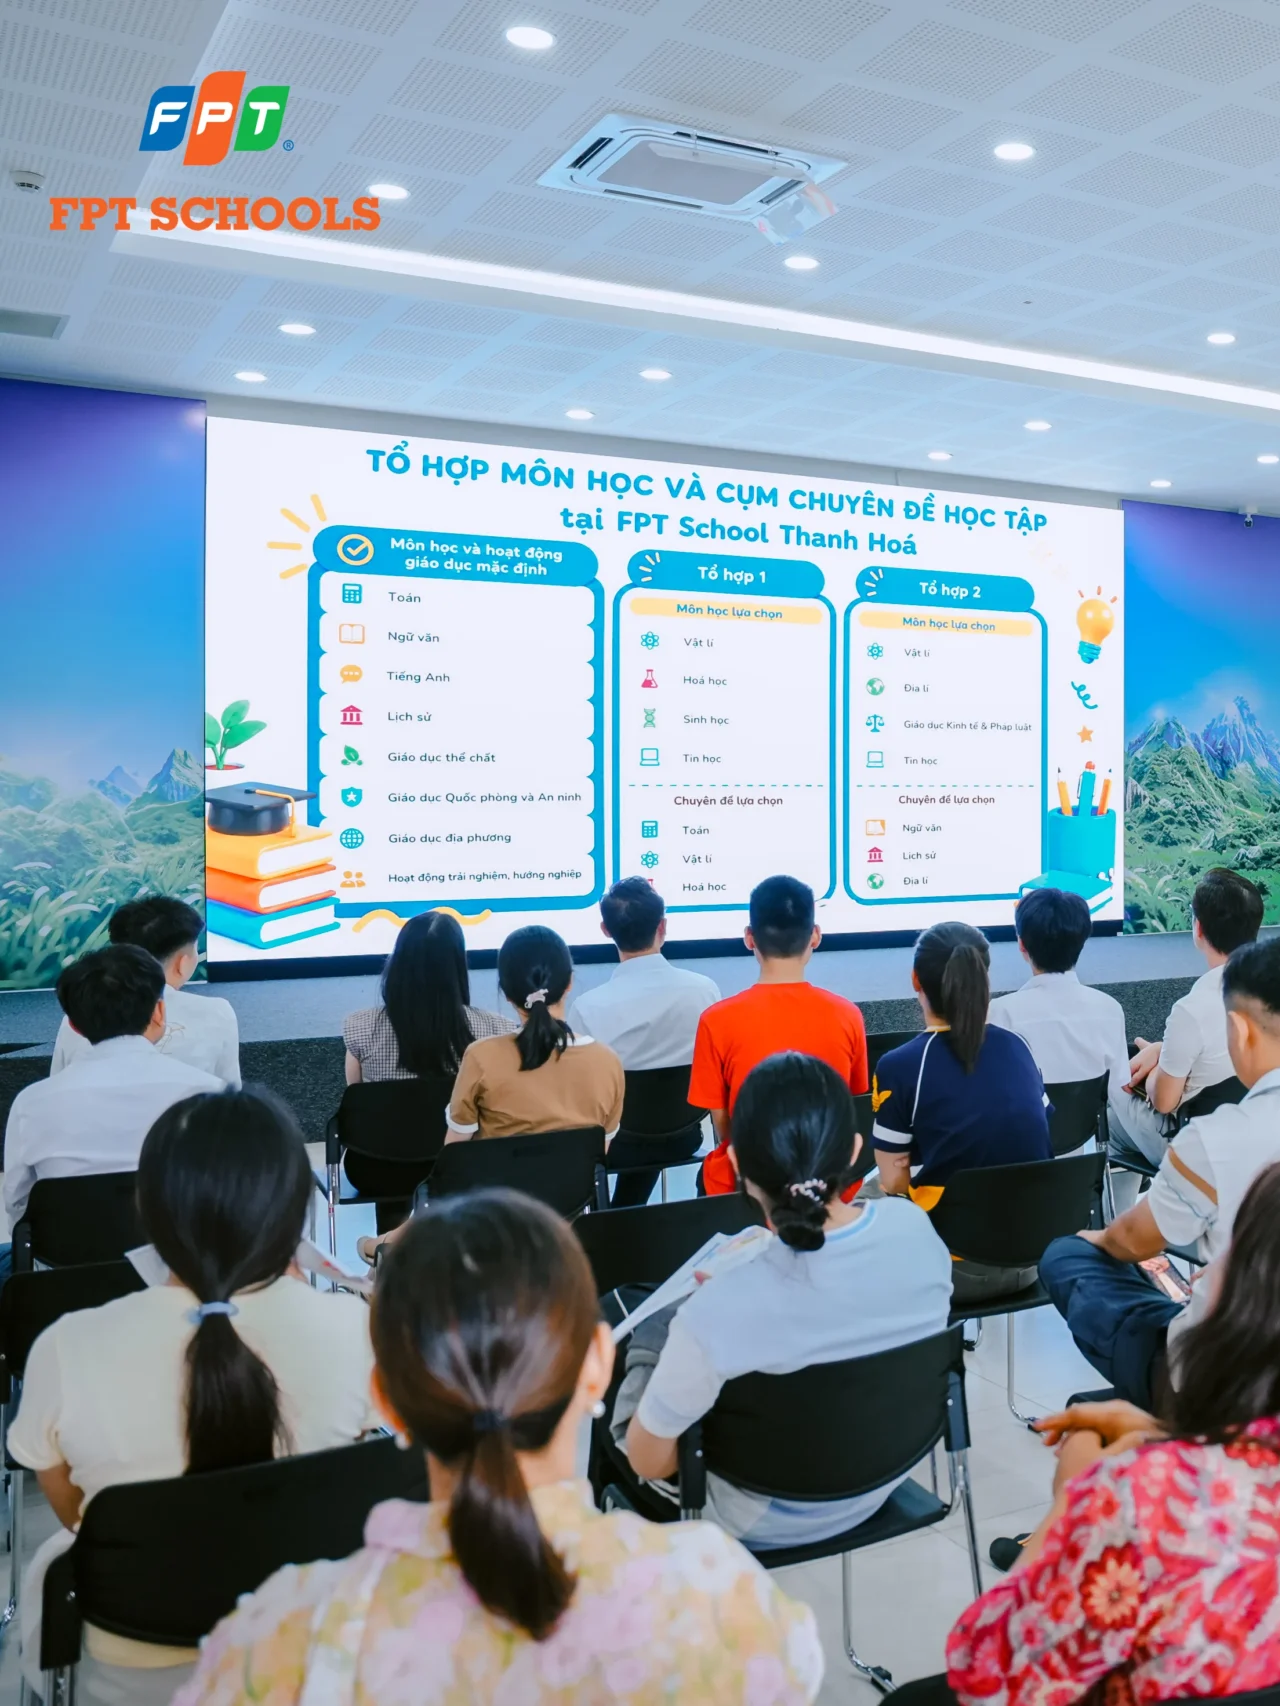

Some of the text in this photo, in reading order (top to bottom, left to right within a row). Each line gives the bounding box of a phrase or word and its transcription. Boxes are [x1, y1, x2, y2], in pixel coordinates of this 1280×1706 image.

[366, 440, 1047, 536] TỔ HỢP MÔN HỌC VÀ CỤM CHUYÊN ĐỀ HỌC TẬP
[560, 507, 917, 555] tại FPT School Thanh Hoá
[390, 538, 563, 563] Môn học và hoạt động
[405, 556, 547, 577] giáo dục mặc định
[698, 564, 766, 585] Tổ hợp 1
[919, 580, 981, 600] Tổ hợp 2
[387, 591, 422, 604] Toán
[676, 603, 783, 620] Môn học lựa chọn
[902, 617, 995, 632] Môn học lựa chọn
[387, 631, 440, 644] Ngữ văn
[683, 637, 704, 649] Vật
[903, 647, 922, 660] Vật
[385, 670, 451, 684] Tiếng Anh
[682, 675, 728, 688] Hoá học
[683, 714, 730, 727] Sinh học
[903, 719, 926, 730] Giáo
[926, 720, 945, 731] dục
[946, 720, 968, 730] Kinh
[980, 721, 988, 731] &
[387, 751, 496, 765] Giáo dục thể chất
[682, 753, 722, 765] Tin học
[903, 755, 939, 767] Tin học
[387, 791, 582, 805] Giáo dục Quốc phòng và An ninh
[673, 794, 717, 808] Chuyên
[736, 795, 755, 808] lựa
[756, 795, 784, 808] chọn
[897, 794, 937, 807] Chuyên
[953, 794, 970, 806] lựa
[971, 794, 996, 806] chọn
[681, 824, 710, 836] Toán
[902, 823, 943, 835] Ngữ văn
[388, 832, 512, 846] Giáo dục địa phương
[681, 853, 703, 866] Vật
[388, 873, 416, 885] Hoạt
[417, 872, 446, 884] động
[468, 870, 511, 883] nghiệm,
[512, 870, 546, 881] hướng
[547, 868, 583, 881] nghiệp
[682, 881, 727, 893] Hoá học
